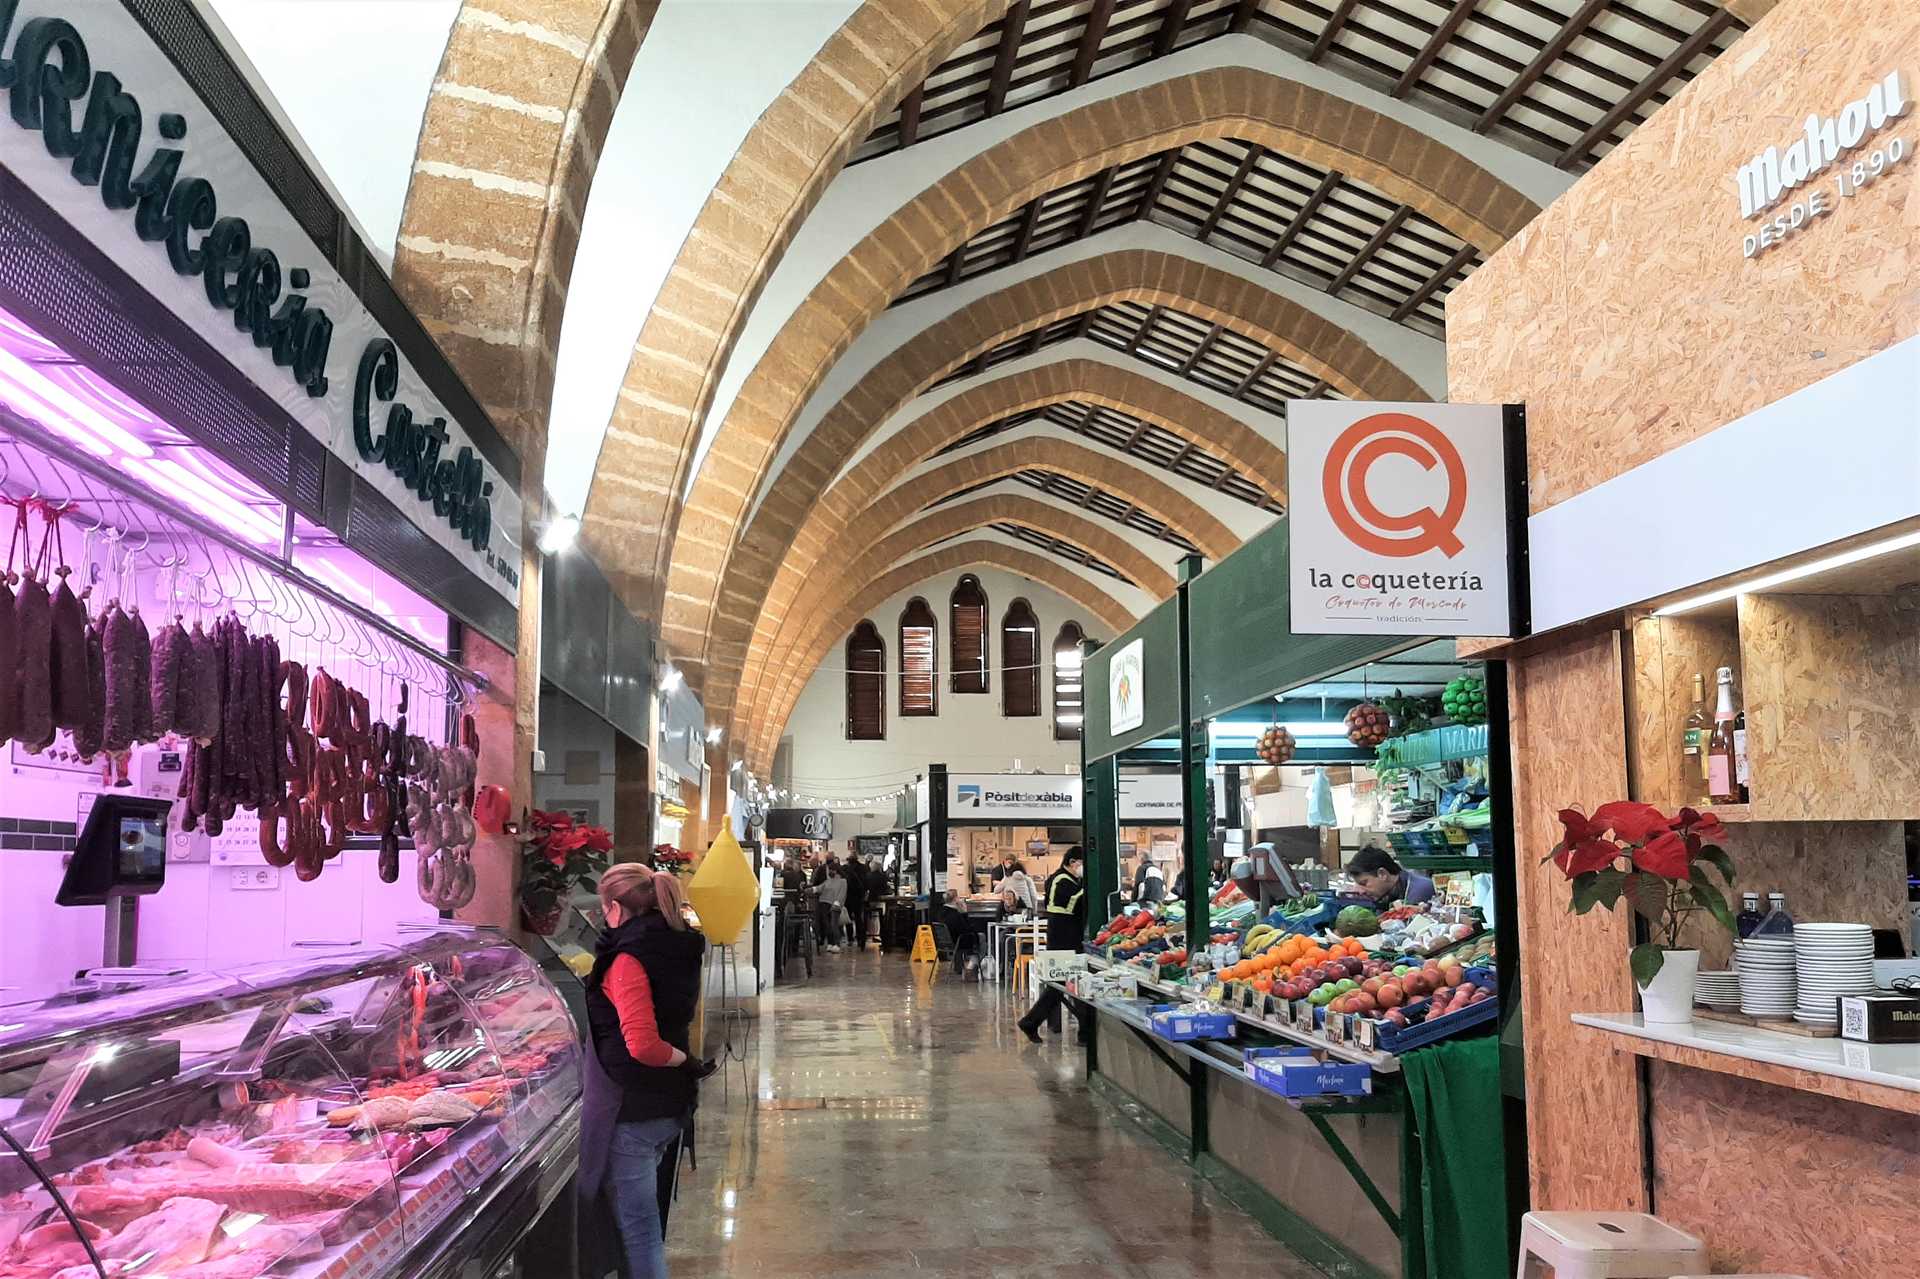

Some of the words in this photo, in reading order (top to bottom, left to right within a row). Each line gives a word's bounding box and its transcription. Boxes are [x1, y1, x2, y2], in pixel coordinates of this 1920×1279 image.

[1736, 69, 1906, 220] Mahou
[1744, 190, 1827, 258] DESDE
[1834, 137, 1906, 198] 1890
[1309, 568, 1333, 588] la
[1342, 571, 1483, 593] coquetería
[1376, 615, 1423, 624] tradición
